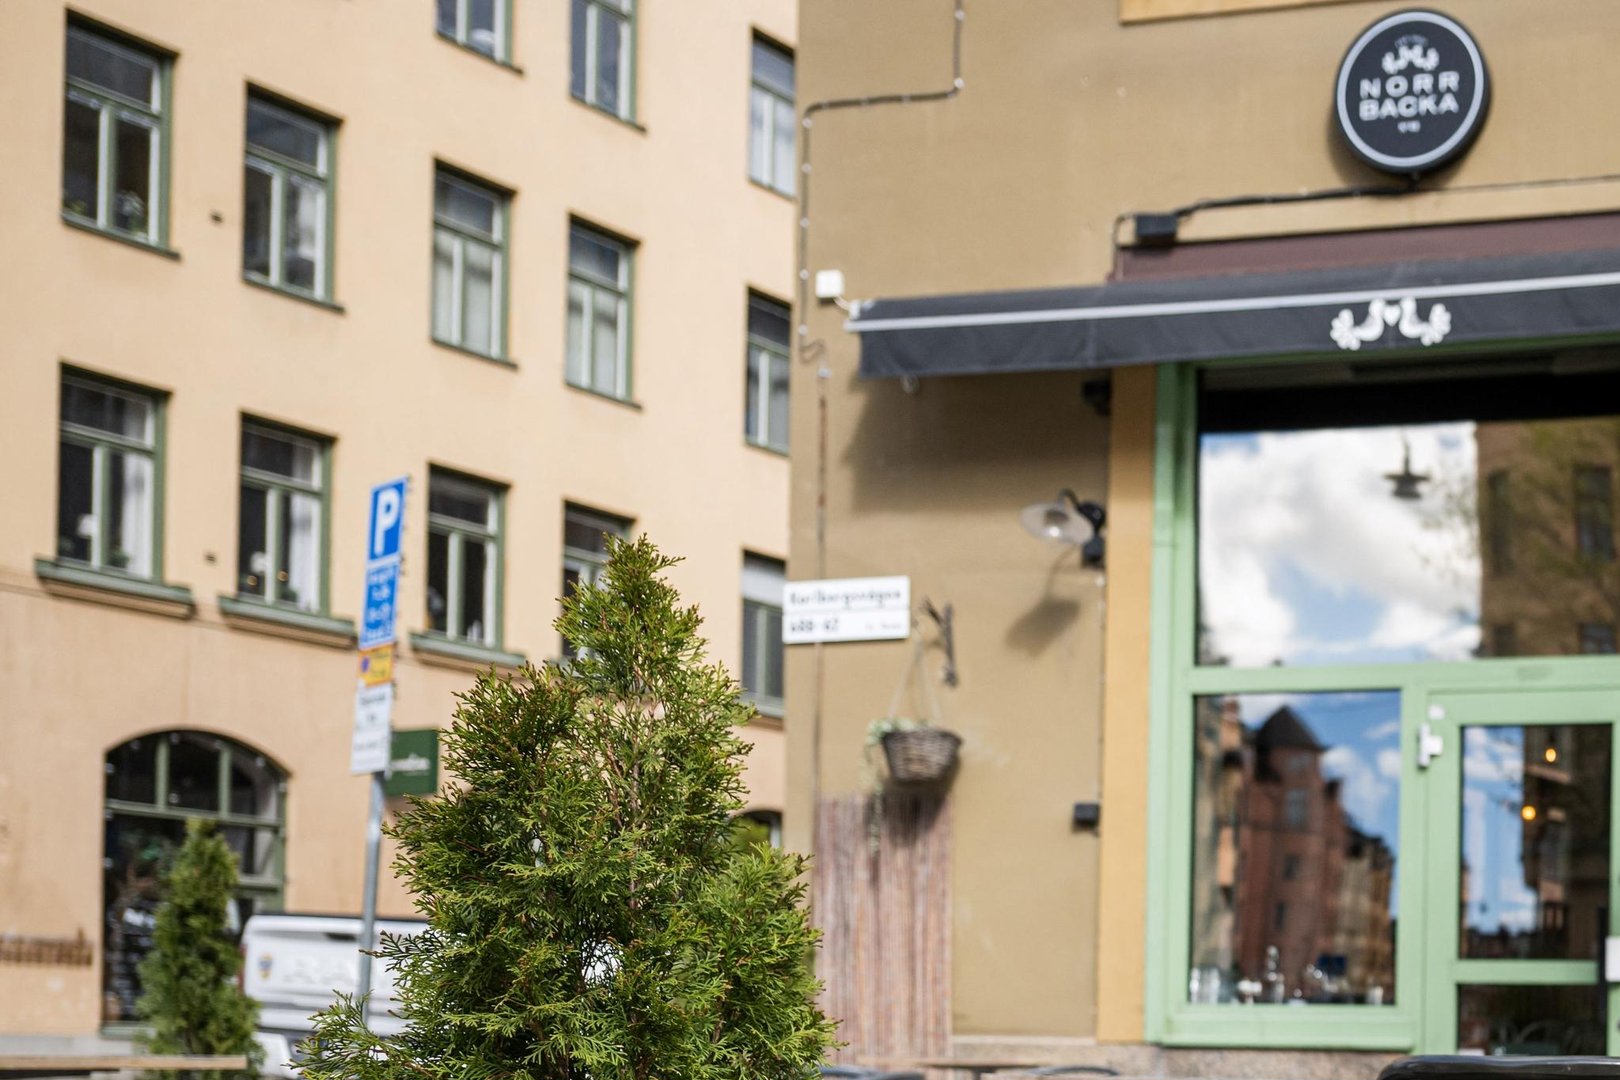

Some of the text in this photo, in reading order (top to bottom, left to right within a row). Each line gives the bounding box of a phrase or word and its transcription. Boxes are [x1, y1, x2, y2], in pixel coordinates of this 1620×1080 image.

[1359, 71, 1460, 99] NORR
[1358, 93, 1460, 121] BACKA
[373, 485, 400, 555] P
